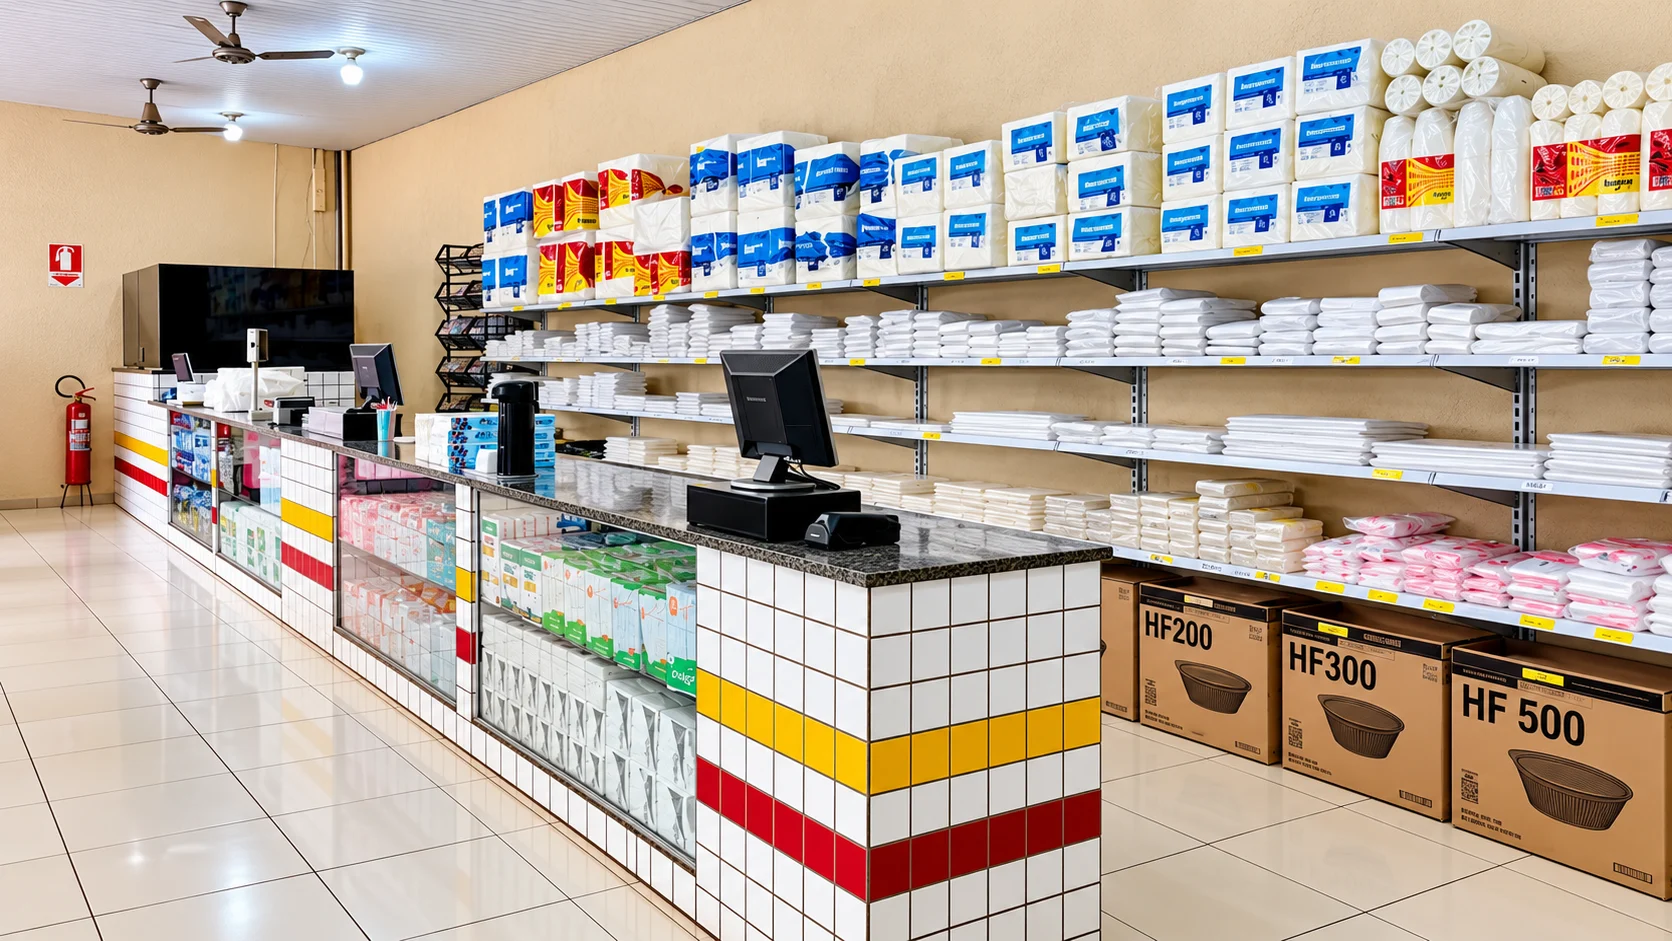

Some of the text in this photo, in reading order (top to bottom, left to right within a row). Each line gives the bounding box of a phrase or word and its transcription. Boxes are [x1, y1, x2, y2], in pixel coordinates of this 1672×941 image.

[1145, 610, 1213, 651] HF200
[1289, 641, 1377, 691] HF300
[1463, 683, 1585, 747] HF 500
